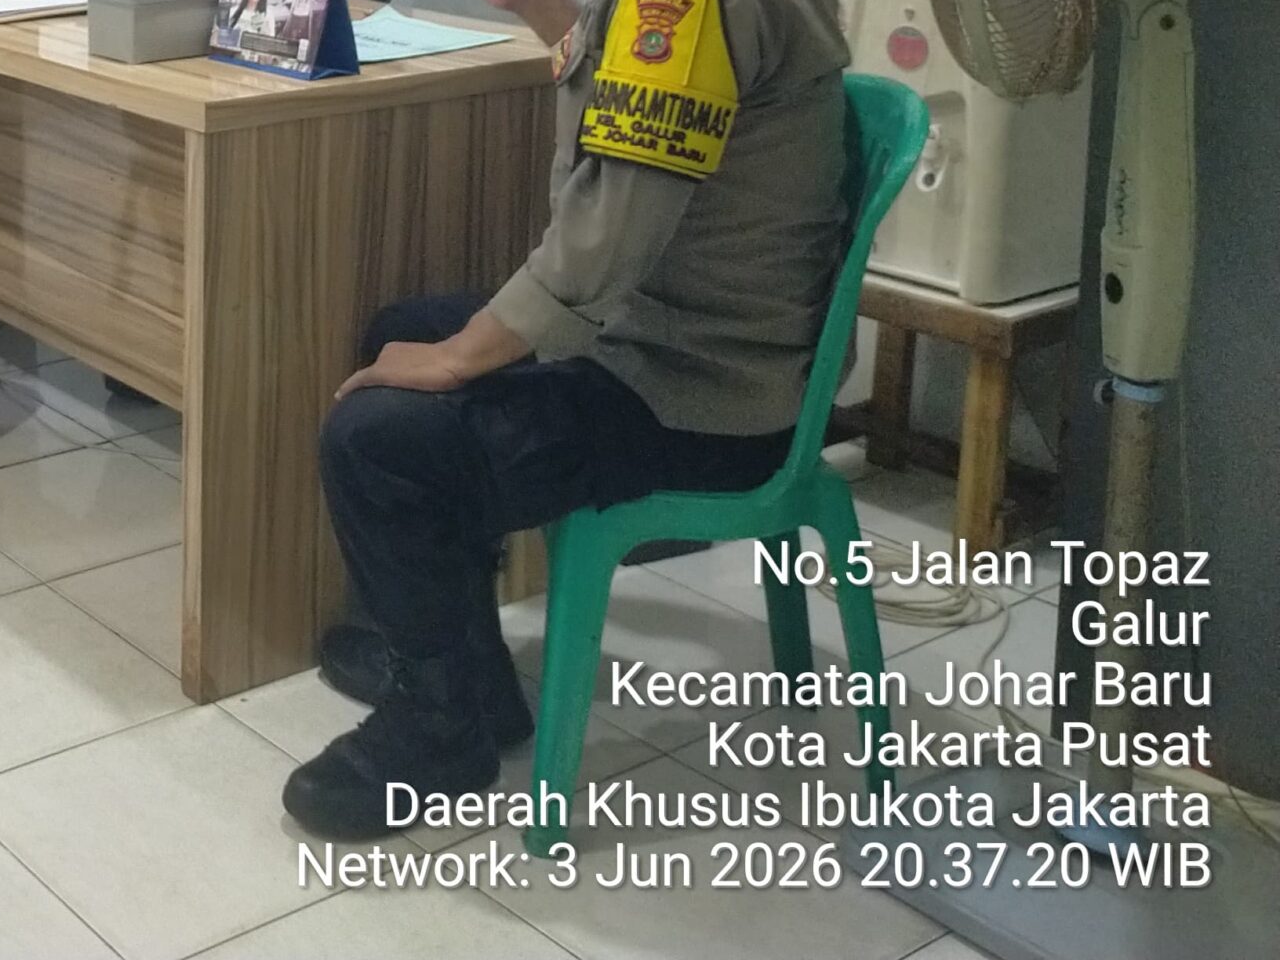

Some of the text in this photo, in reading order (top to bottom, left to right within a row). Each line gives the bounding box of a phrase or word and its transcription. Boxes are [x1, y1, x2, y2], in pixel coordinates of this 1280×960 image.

[603, 128, 659, 151] JOHAR
[666, 142, 707, 164] BARU
[631, 120, 686, 144] GALUR
